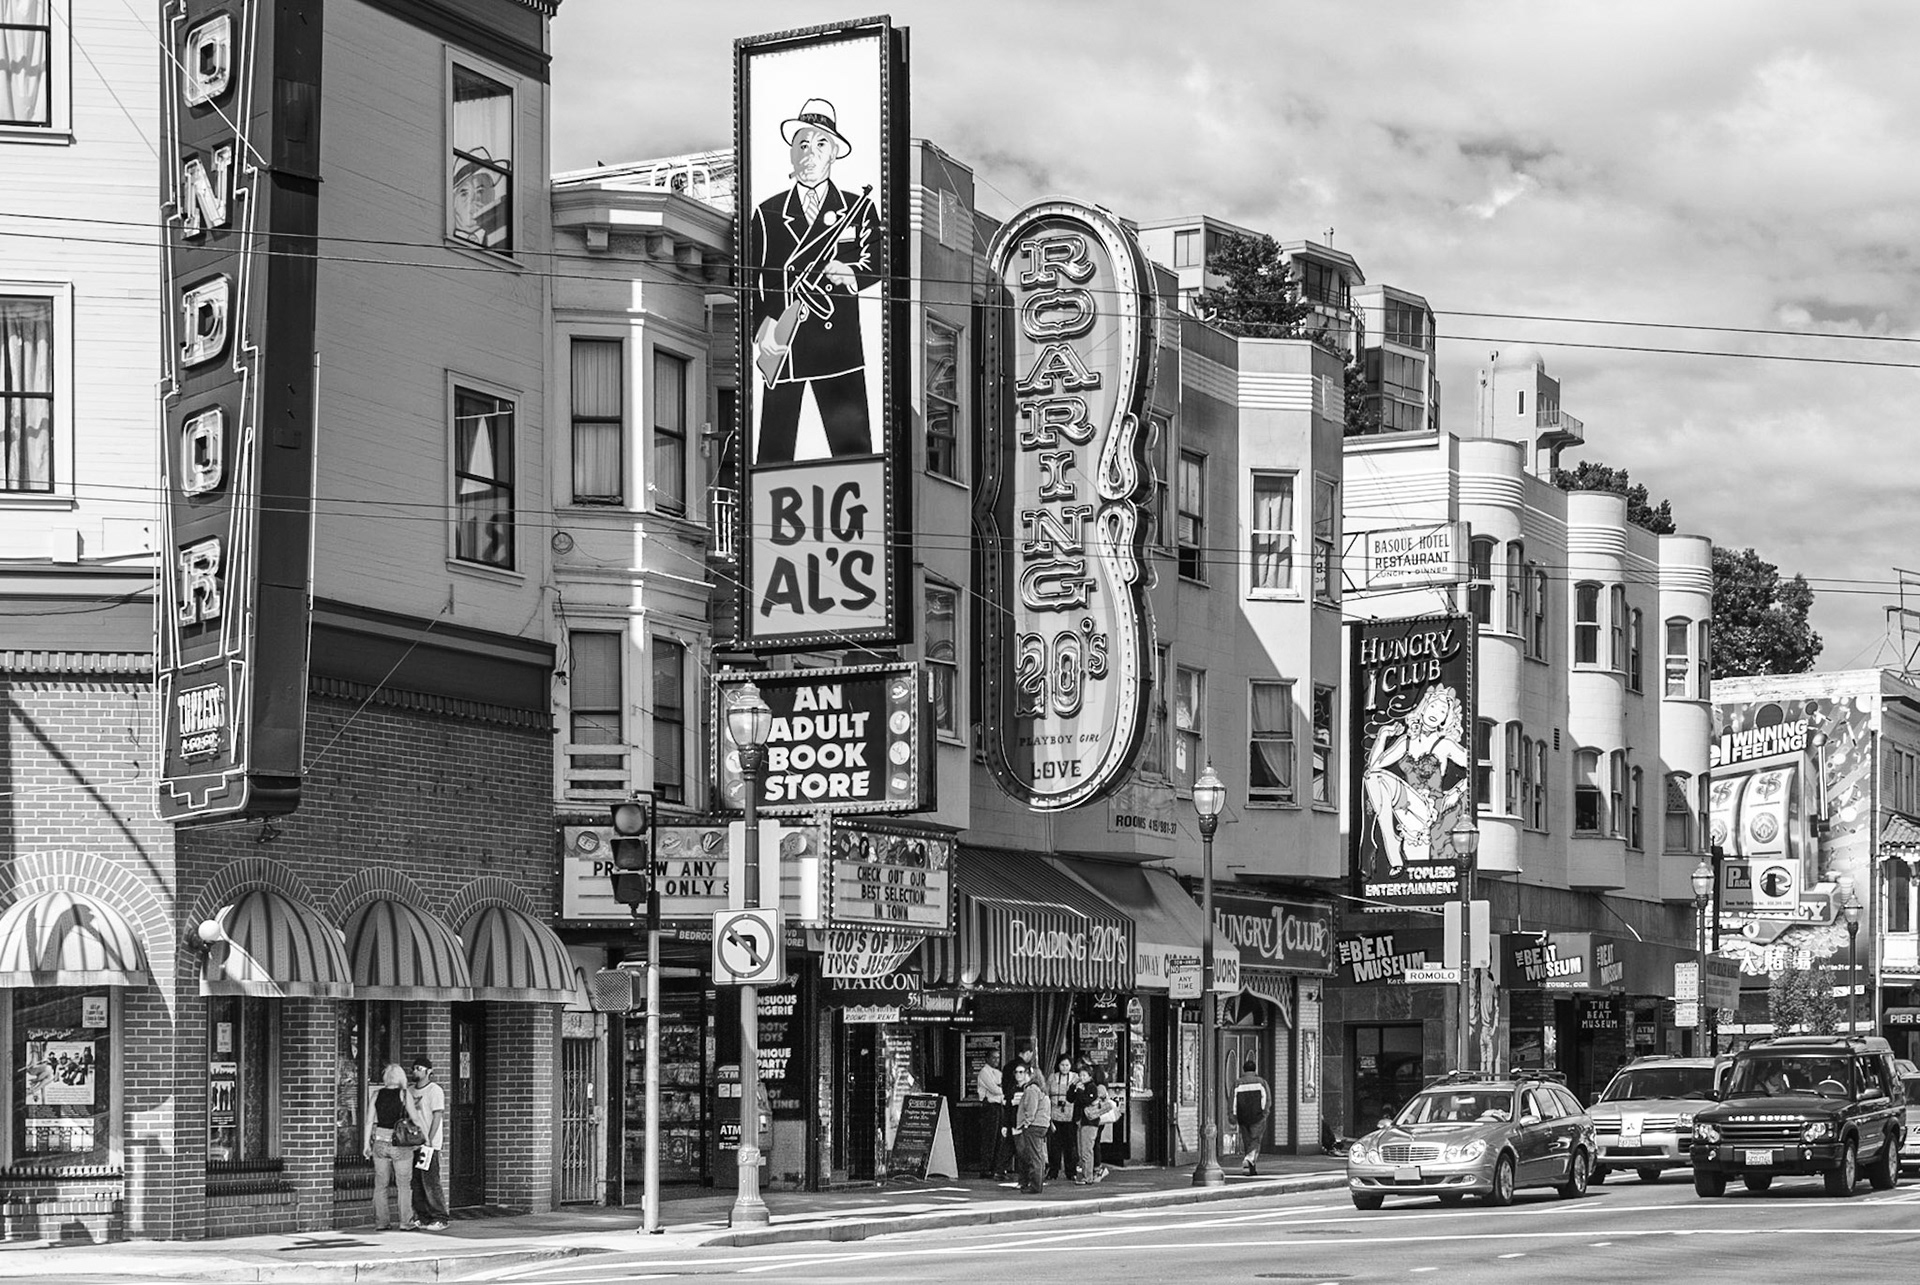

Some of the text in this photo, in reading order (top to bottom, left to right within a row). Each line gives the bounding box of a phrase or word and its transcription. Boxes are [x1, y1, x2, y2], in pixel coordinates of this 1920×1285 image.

[1016, 233, 1102, 613] ROARING
[769, 482, 868, 546] BIG
[1374, 533, 1450, 554] BASQUE HOTEL
[1375, 550, 1450, 569] RESTAURANT
[760, 547, 877, 618] AL'S
[1360, 629, 1460, 665] HUNGRY
[1382, 658, 1441, 692] CLUB
[792, 684, 843, 712] AN
[766, 711, 870, 743] ADULT
[1732, 719, 1808, 748] WINNING
[1019, 733, 1101, 747] PLAYBOY GIRL
[1732, 733, 1807, 762] FEELING!
[768, 741, 868, 772] BOOK
[1030, 759, 1082, 780] LOVE
[764, 770, 871, 801] STORE
[593, 860, 717, 877] PREW ANY
[857, 866, 926, 887] CHECK OUT OUR
[1406, 865, 1456, 880] TOPLESS
[665, 879, 715, 896] ONLY
[861, 884, 925, 904] BEST SELECTION
[1365, 881, 1459, 897] ENTERTAINMENT
[886, 904, 909, 920] TOWN
[786, 938, 805, 948] ORE!
[828, 931, 867, 954] 100'S
[870, 931, 889, 954] OF
[1010, 919, 1087, 961] ROARING
[1285, 914, 1329, 957] CLUB
[1338, 935, 1394, 964] THE BEAT
[1524, 944, 1557, 966] BEAT
[827, 953, 859, 975] TOYS
[1352, 951, 1426, 983] MUSEUM
[1525, 957, 1582, 981] MUSEUM
[832, 973, 919, 990] MARCONI
[1177, 982, 1193, 990] TIME
[1410, 972, 1455, 980] ROMOLO
[757, 994, 797, 1005] NSUOUS
[1590, 1001, 1610, 1009] THE
[757, 1005, 794, 1015] NGERIE
[1586, 1010, 1612, 1019] BEAT
[1890, 1014, 1914, 1024] PIER
[758, 1022, 788, 1032] ROTIC
[1581, 1020, 1619, 1029] MUSEUM
[1636, 1026, 1655, 1034] ATM
[759, 1069, 786, 1079] GIFTS
[720, 1125, 742, 1135] ATM
